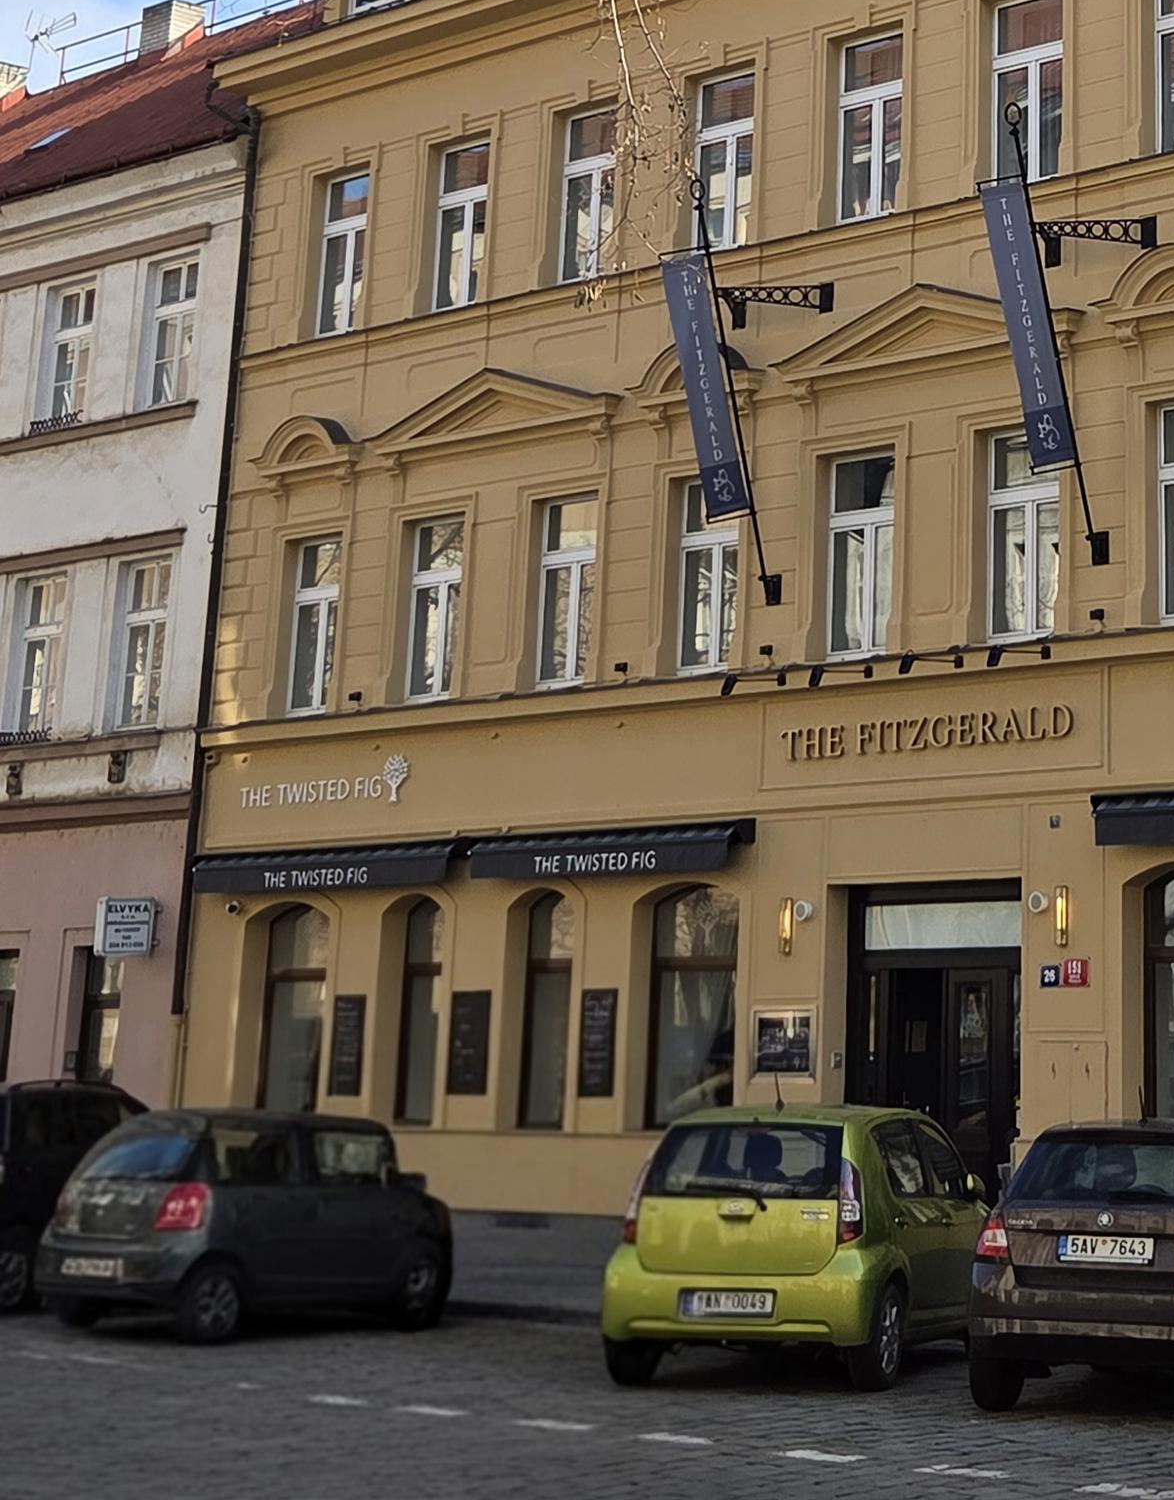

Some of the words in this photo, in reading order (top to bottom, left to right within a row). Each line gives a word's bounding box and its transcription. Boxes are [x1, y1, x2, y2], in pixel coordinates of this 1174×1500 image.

[999, 198, 1015, 241] THE
[1011, 253, 1047, 405] FITZGERALD
[681, 271, 697, 311] THE
[691, 321, 723, 462] FITZGERALD
[780, 724, 845, 762] THE
[856, 703, 1075, 756] FITZGERALD
[240, 785, 271, 808] THE
[277, 778, 350, 805] TWISTED
[354, 775, 382, 799] FIG
[534, 855, 560, 873] THE
[566, 852, 628, 872] TWISTED
[631, 850, 656, 869] FIG
[264, 871, 286, 888] THE
[291, 868, 344, 886] TWISTED
[346, 867, 367, 884] FIG
[108, 904, 149, 913] ELVYKA
[1043, 969, 1056, 983] 26
[1071, 1237, 1098, 1254] 5AV
[1110, 1239, 1146, 1256] 7643
[732, 1294, 766, 1310] 0049
